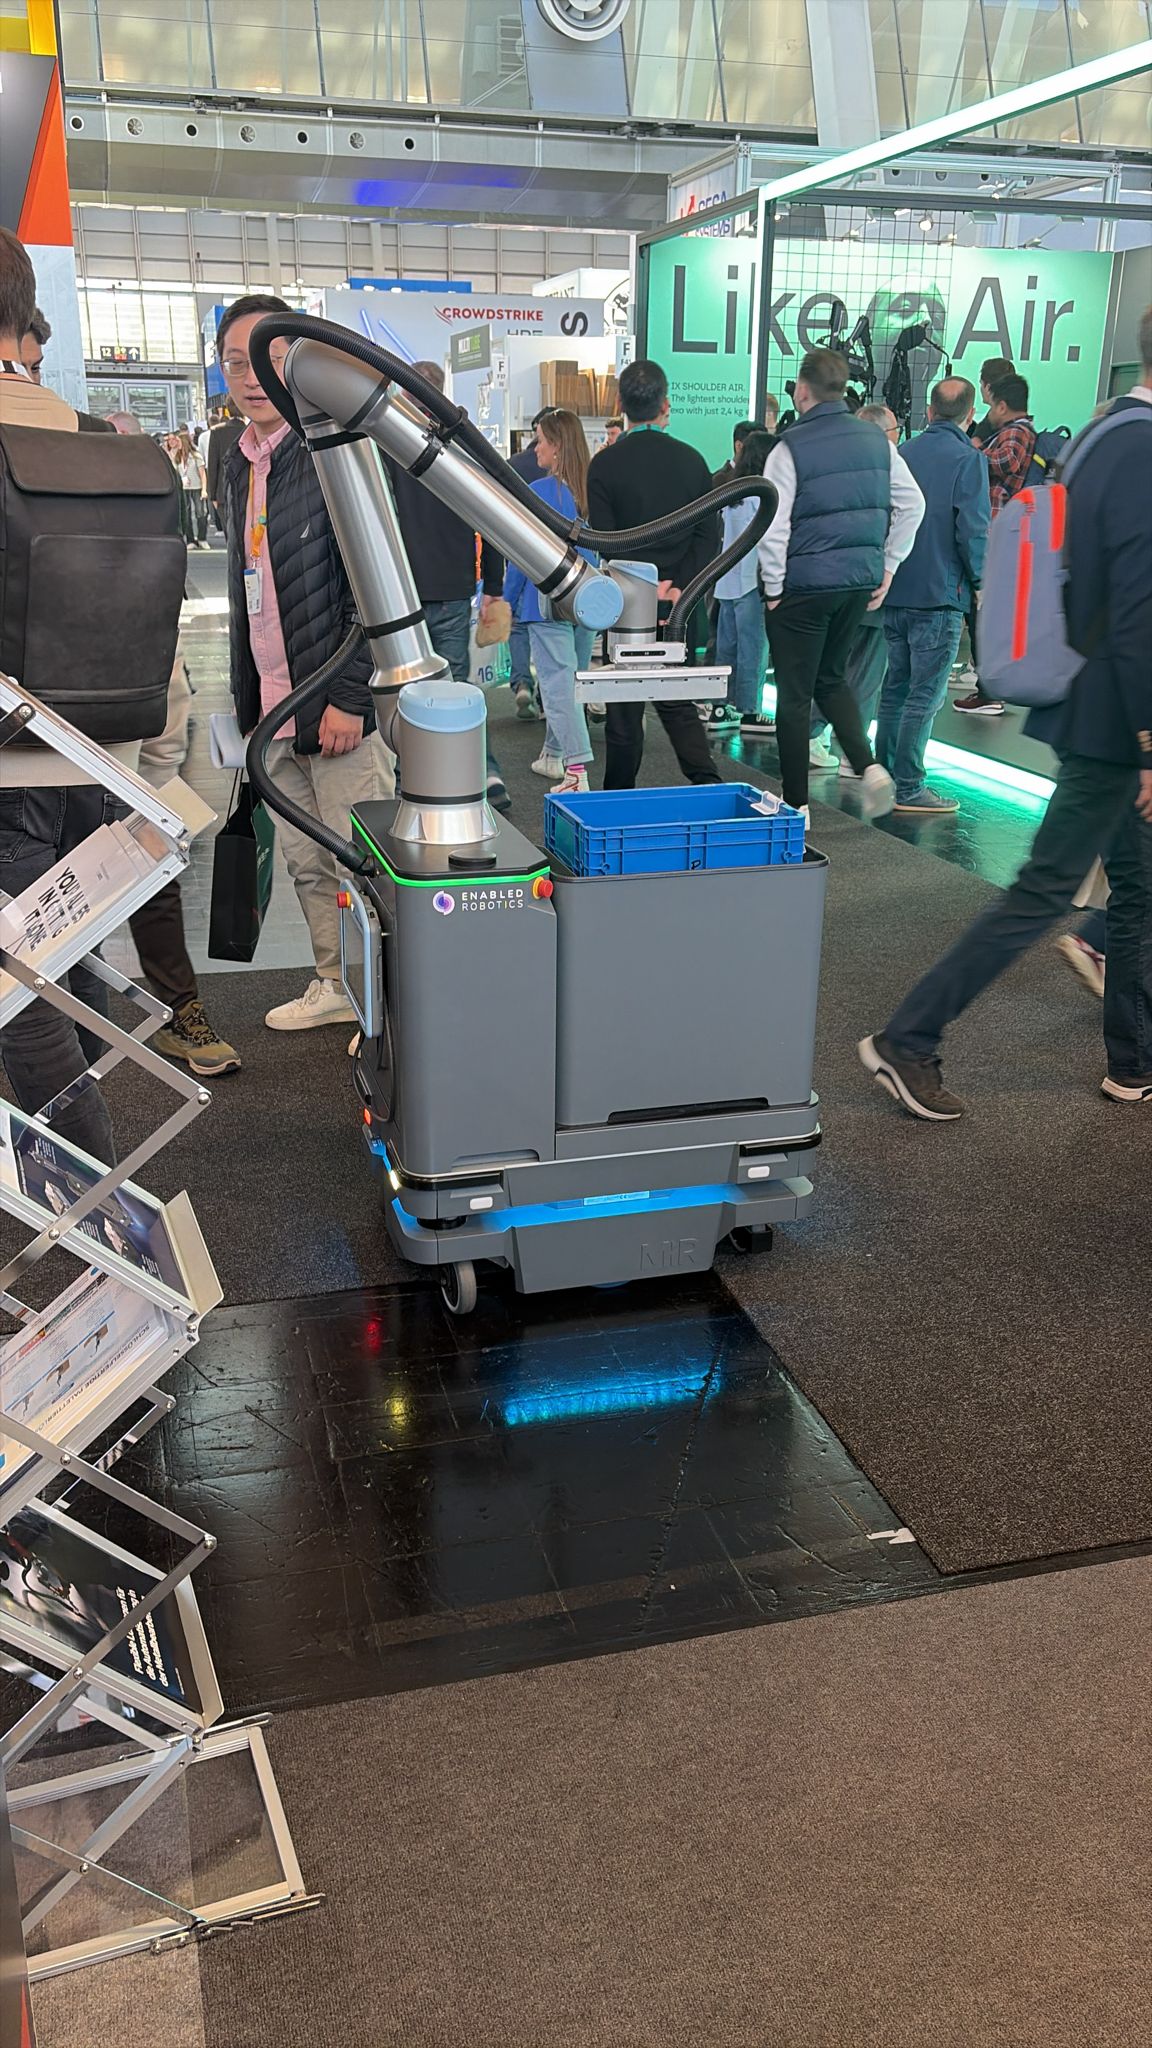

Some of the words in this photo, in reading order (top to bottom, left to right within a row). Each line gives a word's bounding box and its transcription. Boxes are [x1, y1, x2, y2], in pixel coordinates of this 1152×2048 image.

[443, 307, 544, 321] CROWDSTRIKE
[672, 262, 848, 356] Like
[951, 275, 1080, 362] Air.
[682, 382, 727, 391] SHOULDER
[671, 394, 686, 402] The
[687, 394, 716, 405] lightest
[686, 406, 703, 415] with
[704, 407, 719, 416] just
[734, 407, 744, 417] kg
[478, 665, 494, 683] 16
[38, 886, 58, 907] IN
[461, 888, 524, 901] ENABLED
[461, 899, 524, 912] ROBOTICS
[23, 908, 41, 926] IT
